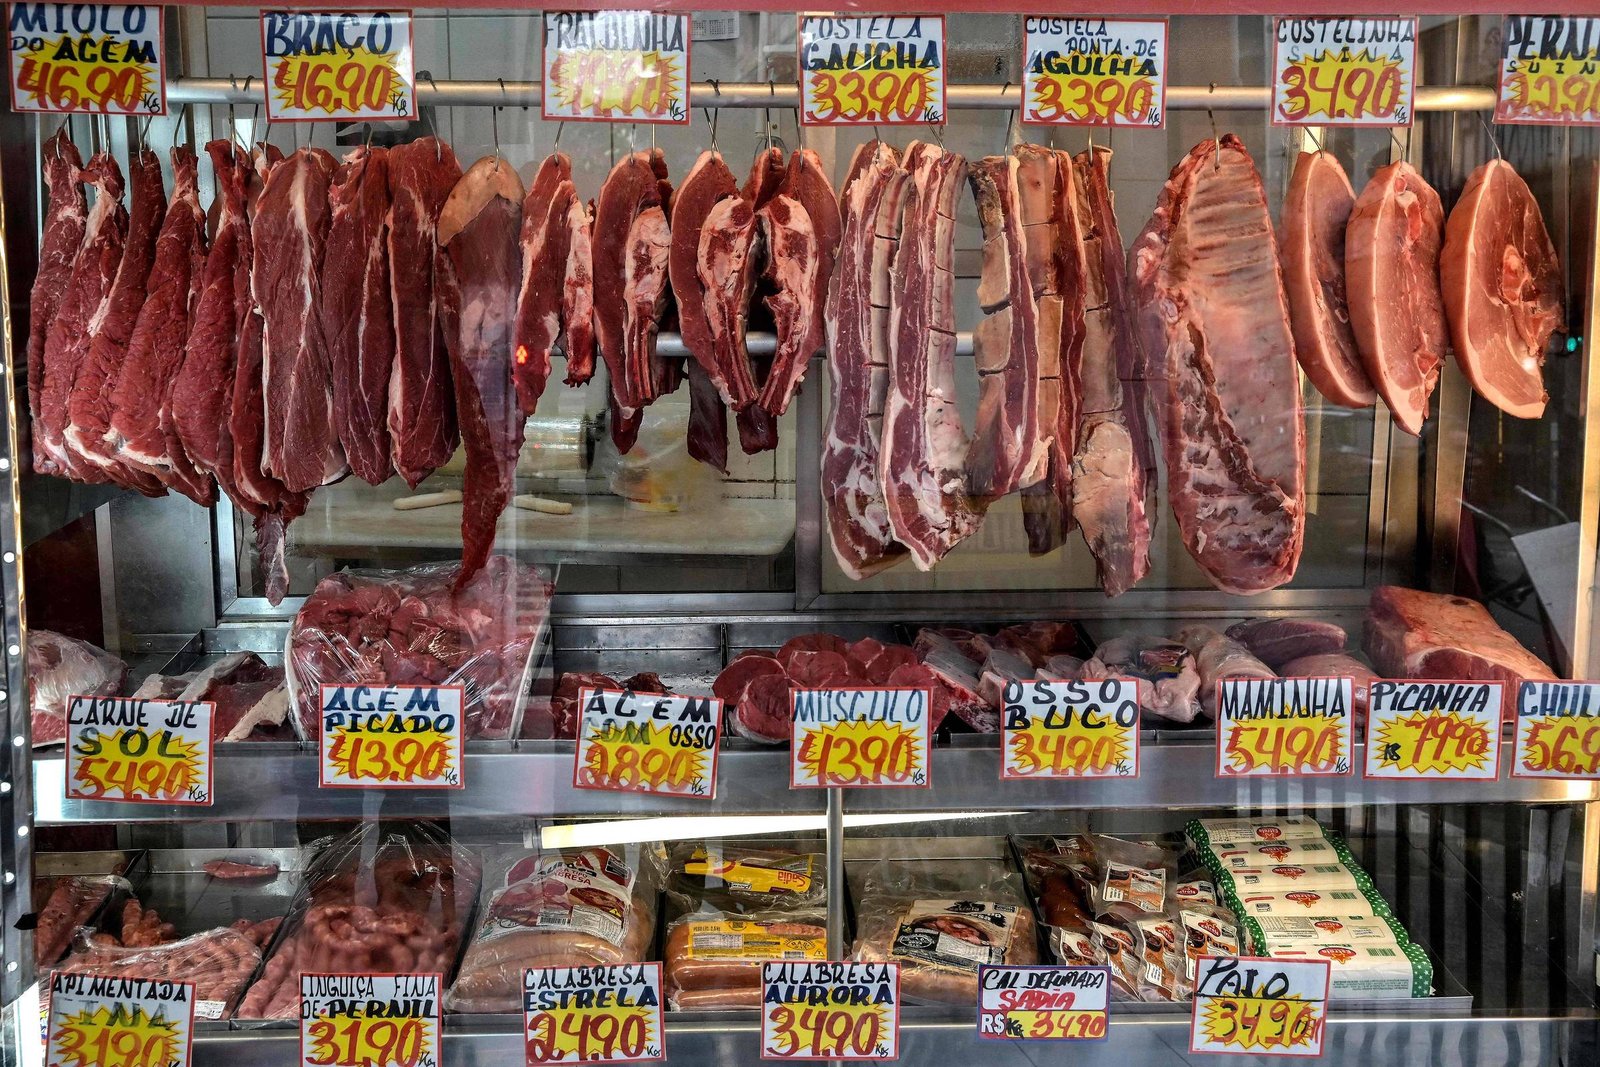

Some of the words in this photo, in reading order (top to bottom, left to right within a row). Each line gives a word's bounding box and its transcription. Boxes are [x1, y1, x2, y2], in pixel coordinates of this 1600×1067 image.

[9, 4, 146, 34] MIOLO
[802, 16, 921, 39] COSTELA
[1026, 16, 1107, 36] COSTELA
[1277, 19, 1414, 43] COSTELINHA
[11, 36, 44, 51] DO
[265, 12, 392, 59] BRAÇO
[1134, 39, 1158, 56] DE
[800, 40, 941, 70] GAUCHA
[1027, 49, 1158, 76] AGULHA
[1288, 45, 1403, 62] SUINA
[18, 59, 142, 112] 46.90
[274, 61, 392, 111] 46.90
[807, 72, 926, 121] 33.90
[1278, 66, 1400, 119] 34.90
[1003, 679, 1121, 704] OSSO
[1218, 678, 1345, 720] MAMINHA
[1517, 681, 1600, 717] CHUL
[68, 697, 149, 727] CARNE
[164, 700, 201, 728] DE
[324, 712, 455, 733] PICADO
[1004, 700, 1139, 730] BUCO
[72, 727, 186, 758] SOL
[669, 724, 717, 749] OSSO
[1224, 727, 1338, 774] 54.90
[328, 735, 447, 782] 43.90
[797, 734, 912, 785] 43.90
[1007, 733, 1115, 776] 34.90
[71, 758, 188, 800] 54.90
[52, 971, 187, 1002] APIMENTADA
[301, 974, 374, 998] LINGUIÇA
[394, 974, 436, 998] FINA
[524, 963, 647, 990] CALABRESA
[763, 961, 891, 984] CALABRESA
[982, 969, 1021, 990] CAL
[1197, 956, 1289, 999] PAIO
[324, 999, 438, 1019] PERNIL
[524, 985, 658, 1012] ESTRELA
[764, 983, 894, 1007] AURORA
[998, 988, 1076, 1010] SADIA
[53, 997, 169, 1030] FINA
[981, 1012, 1005, 1035] R$
[527, 1012, 646, 1062] 24.90
[766, 1007, 880, 1057] 34.90
